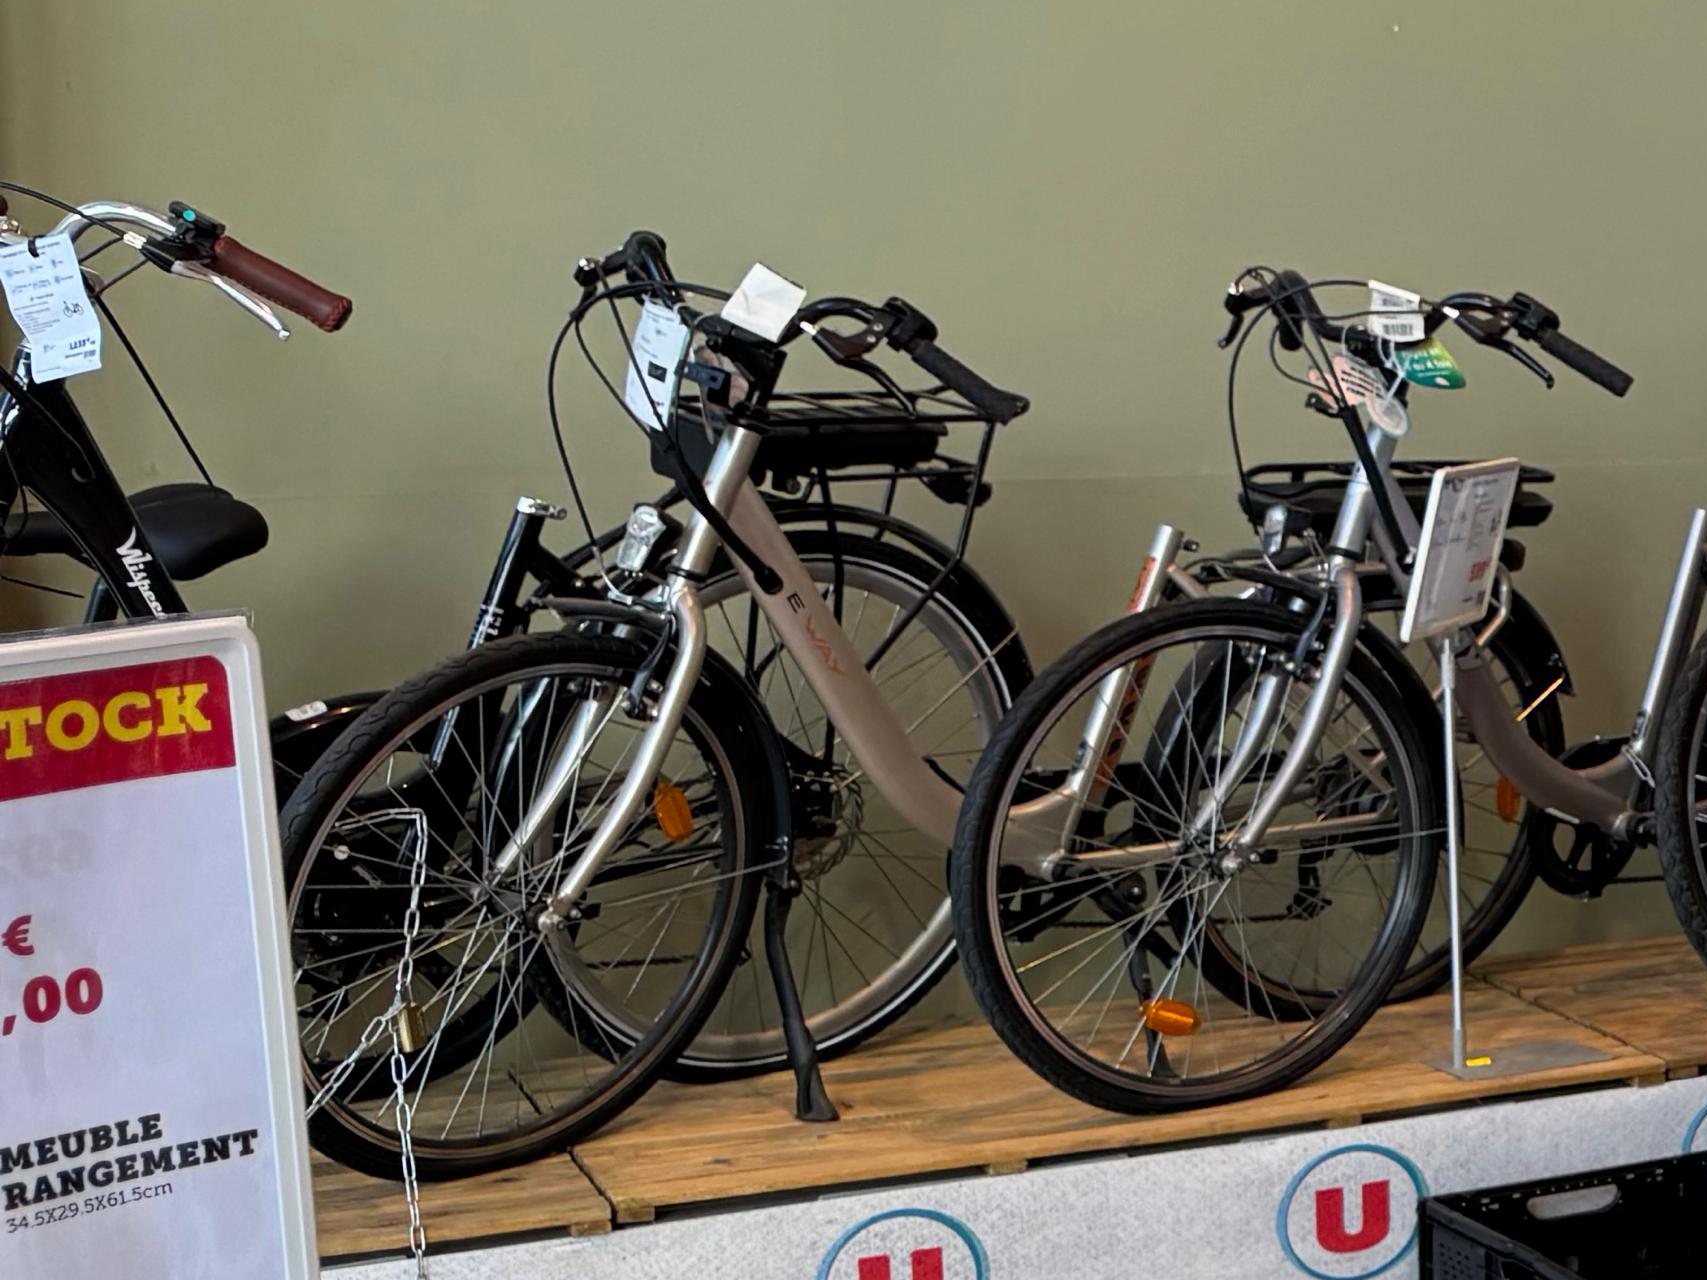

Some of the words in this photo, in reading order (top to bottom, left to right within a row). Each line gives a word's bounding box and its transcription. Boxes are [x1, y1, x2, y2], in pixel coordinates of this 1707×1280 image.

[804, 617, 845, 676] WAY
[0, 682, 212, 761] TOCK
[0, 967, 104, 1037] ,00
[0, 1113, 164, 1176] MEUBLE
[1, 1129, 259, 1212] RANGEMENT
[1315, 1179, 1391, 1254] U
